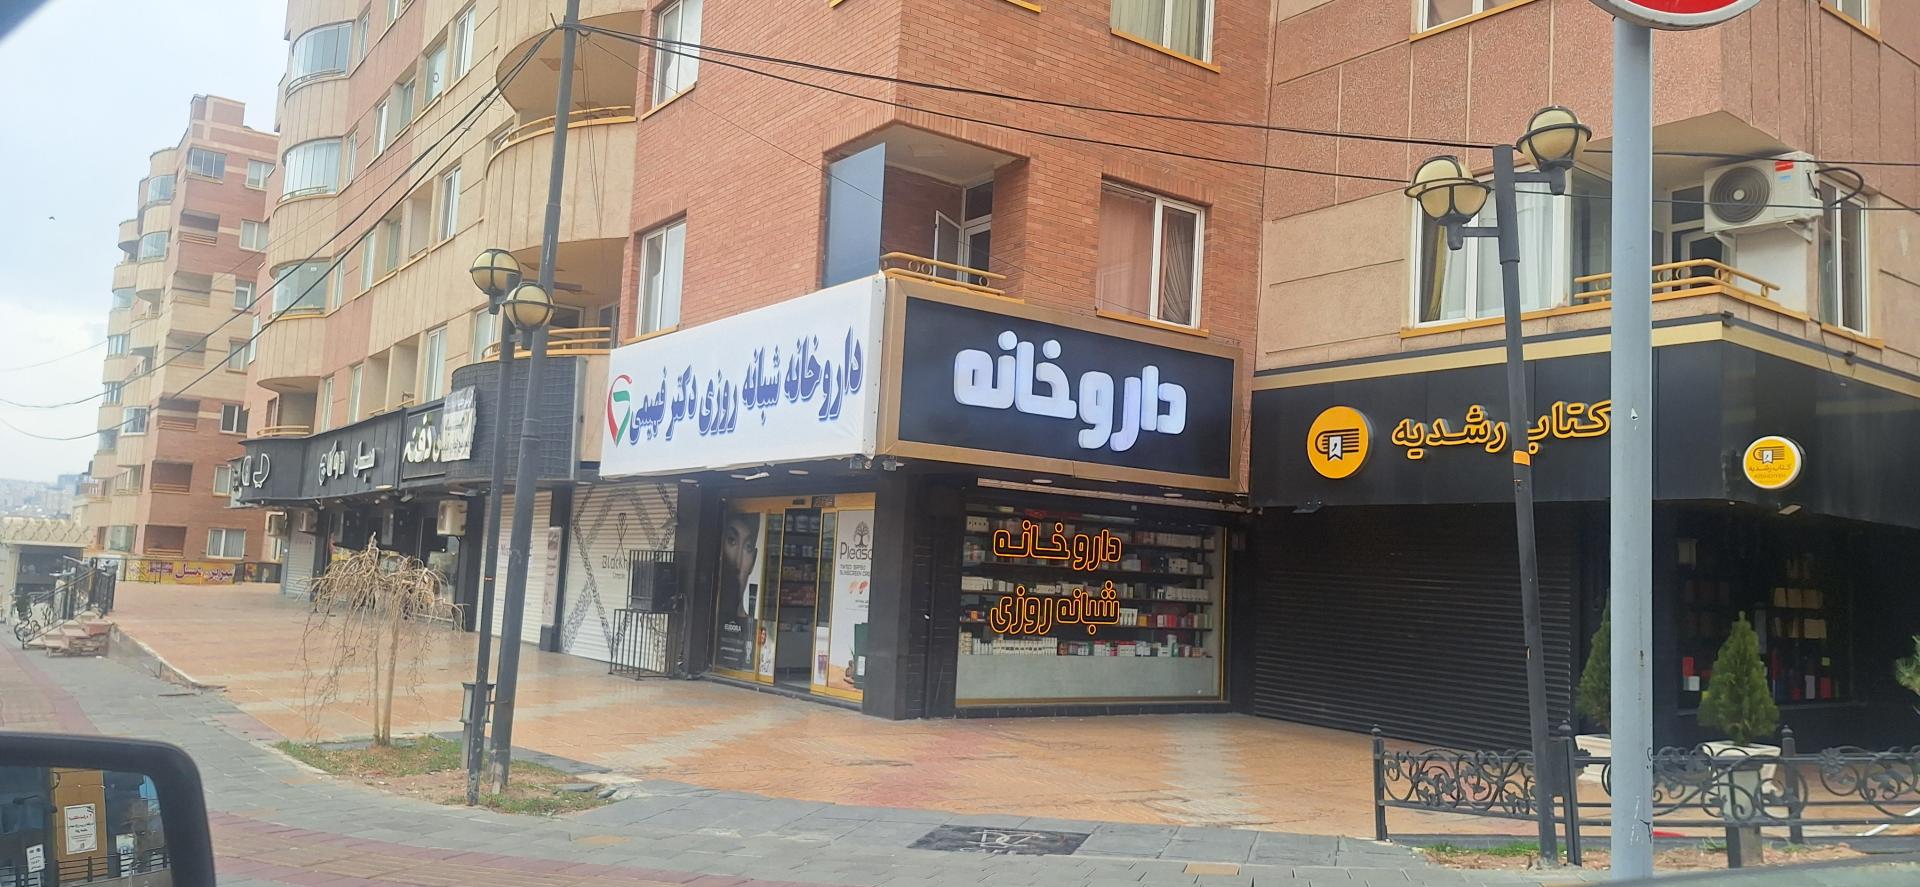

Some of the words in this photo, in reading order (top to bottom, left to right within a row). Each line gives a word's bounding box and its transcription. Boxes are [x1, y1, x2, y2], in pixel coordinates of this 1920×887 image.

[665, 363, 697, 441] دکتر
[699, 368, 738, 436] روزی
[742, 345, 781, 427] شبانه
[785, 324, 864, 420] داروخانه
[954, 330, 1187, 452] داروخانه
[1391, 404, 1509, 460] رشدیه
[993, 519, 1122, 571] داروخانه
[990, 585, 1052, 635] روزی
[1056, 580, 1121, 636] شبانه
